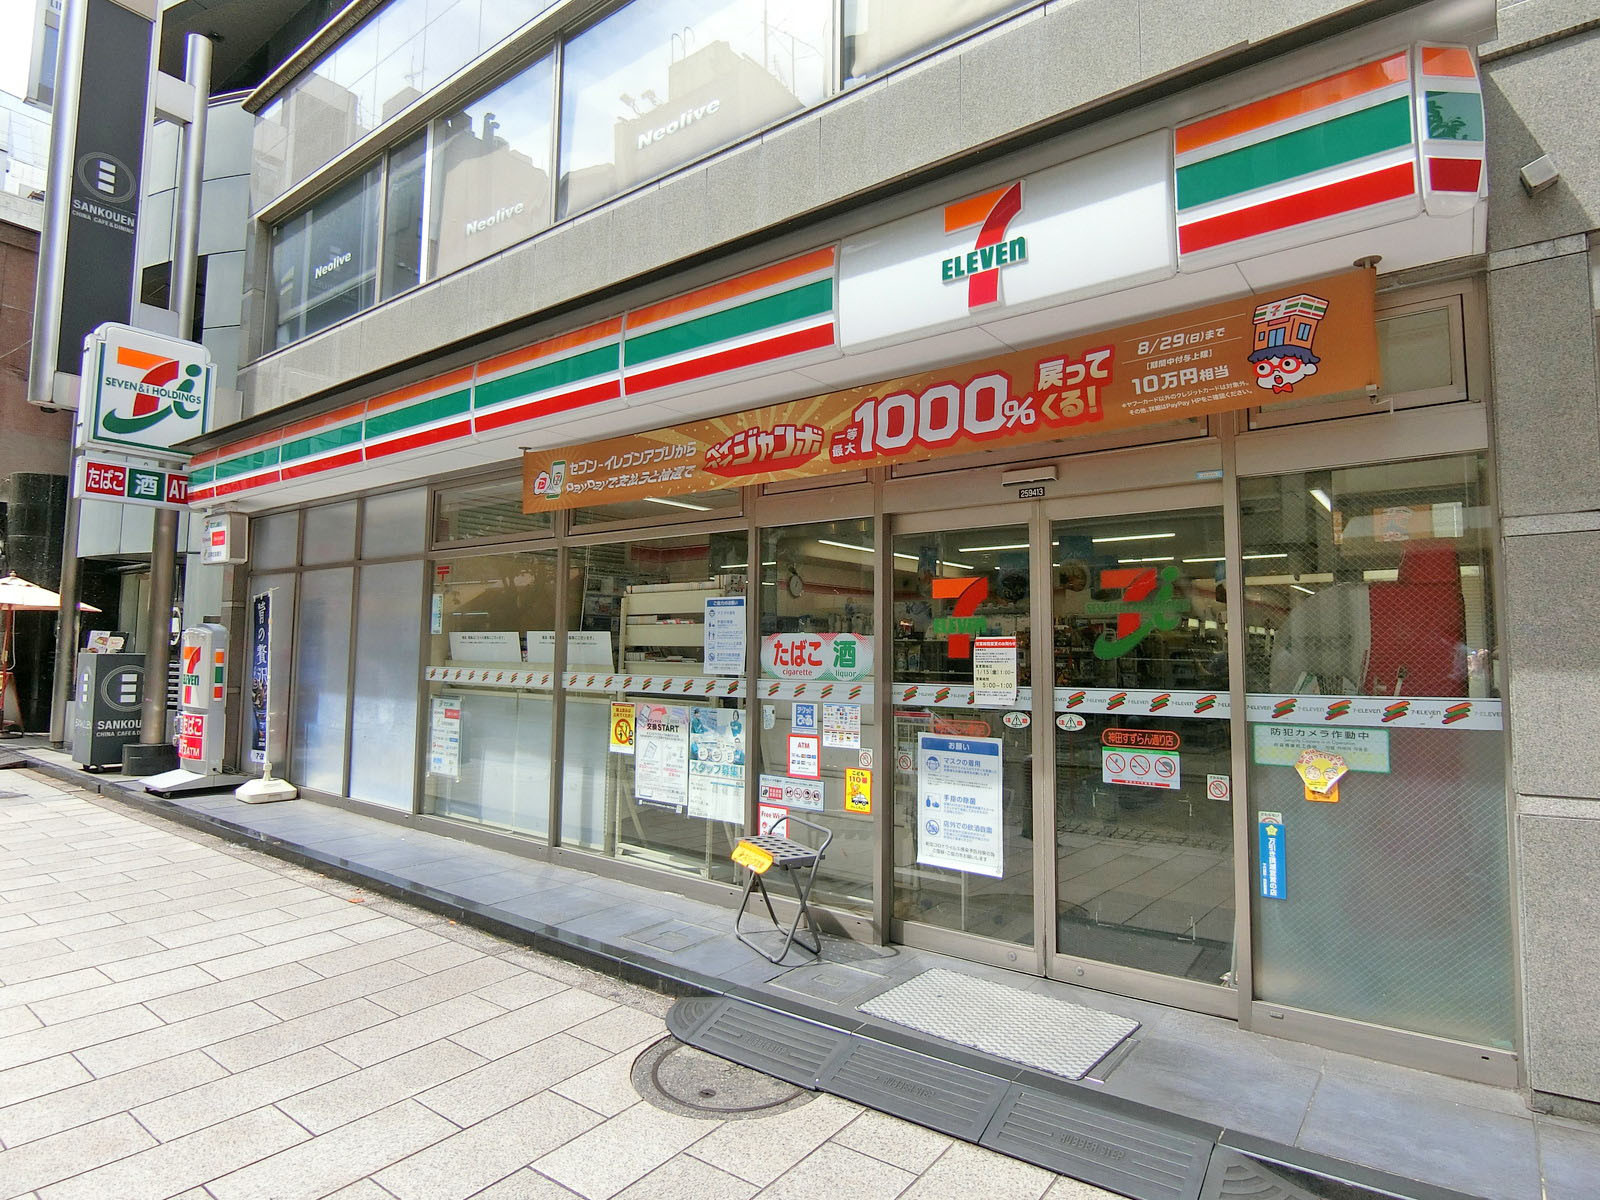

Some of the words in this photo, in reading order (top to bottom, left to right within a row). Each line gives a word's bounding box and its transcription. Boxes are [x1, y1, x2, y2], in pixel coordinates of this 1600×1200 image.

[637, 98, 721, 150] Neolive
[72, 199, 135, 227] SANKOUEN
[72, 209, 92, 221] CHINA
[465, 200, 525, 236] Neolive
[944, 181, 1022, 308] 7
[314, 251, 352, 279] Neolive
[1137, 327, 1225, 355] 8/29(日)まで
[1037, 349, 1111, 391] 戻って
[1131, 364, 1229, 395] 10万円相当
[152, 386, 202, 405] HOLDINGS
[1041, 385, 1097, 420] くる!
[855, 373, 1036, 453] 1000%
[732, 426, 824, 466] ジャンボ
[835, 428, 858, 440] 一等
[569, 441, 697, 476] セブン-イレブンアプリから
[832, 442, 857, 457] 最大
[87, 468, 124, 491] たばこ
[134, 473, 159, 498] 酒
[566, 465, 697, 493] PayPayで支払うと抽選で
[1020, 487, 1044, 498] 259413
[773, 639, 823, 667] たばこ
[833, 639, 857, 668] 酒
[782, 668, 813, 677] cigarette
[835, 669, 857, 678] liquor
[797, 741, 810, 749] ATM
[948, 742, 970, 751] お願い
[1108, 731, 1174, 747] 神田すずらん通り店
[1270, 727, 1370, 740] 防犯カメラ作動中
[690, 762, 743, 779] スタッフ募集!
[943, 757, 981, 768] マスクの着用
